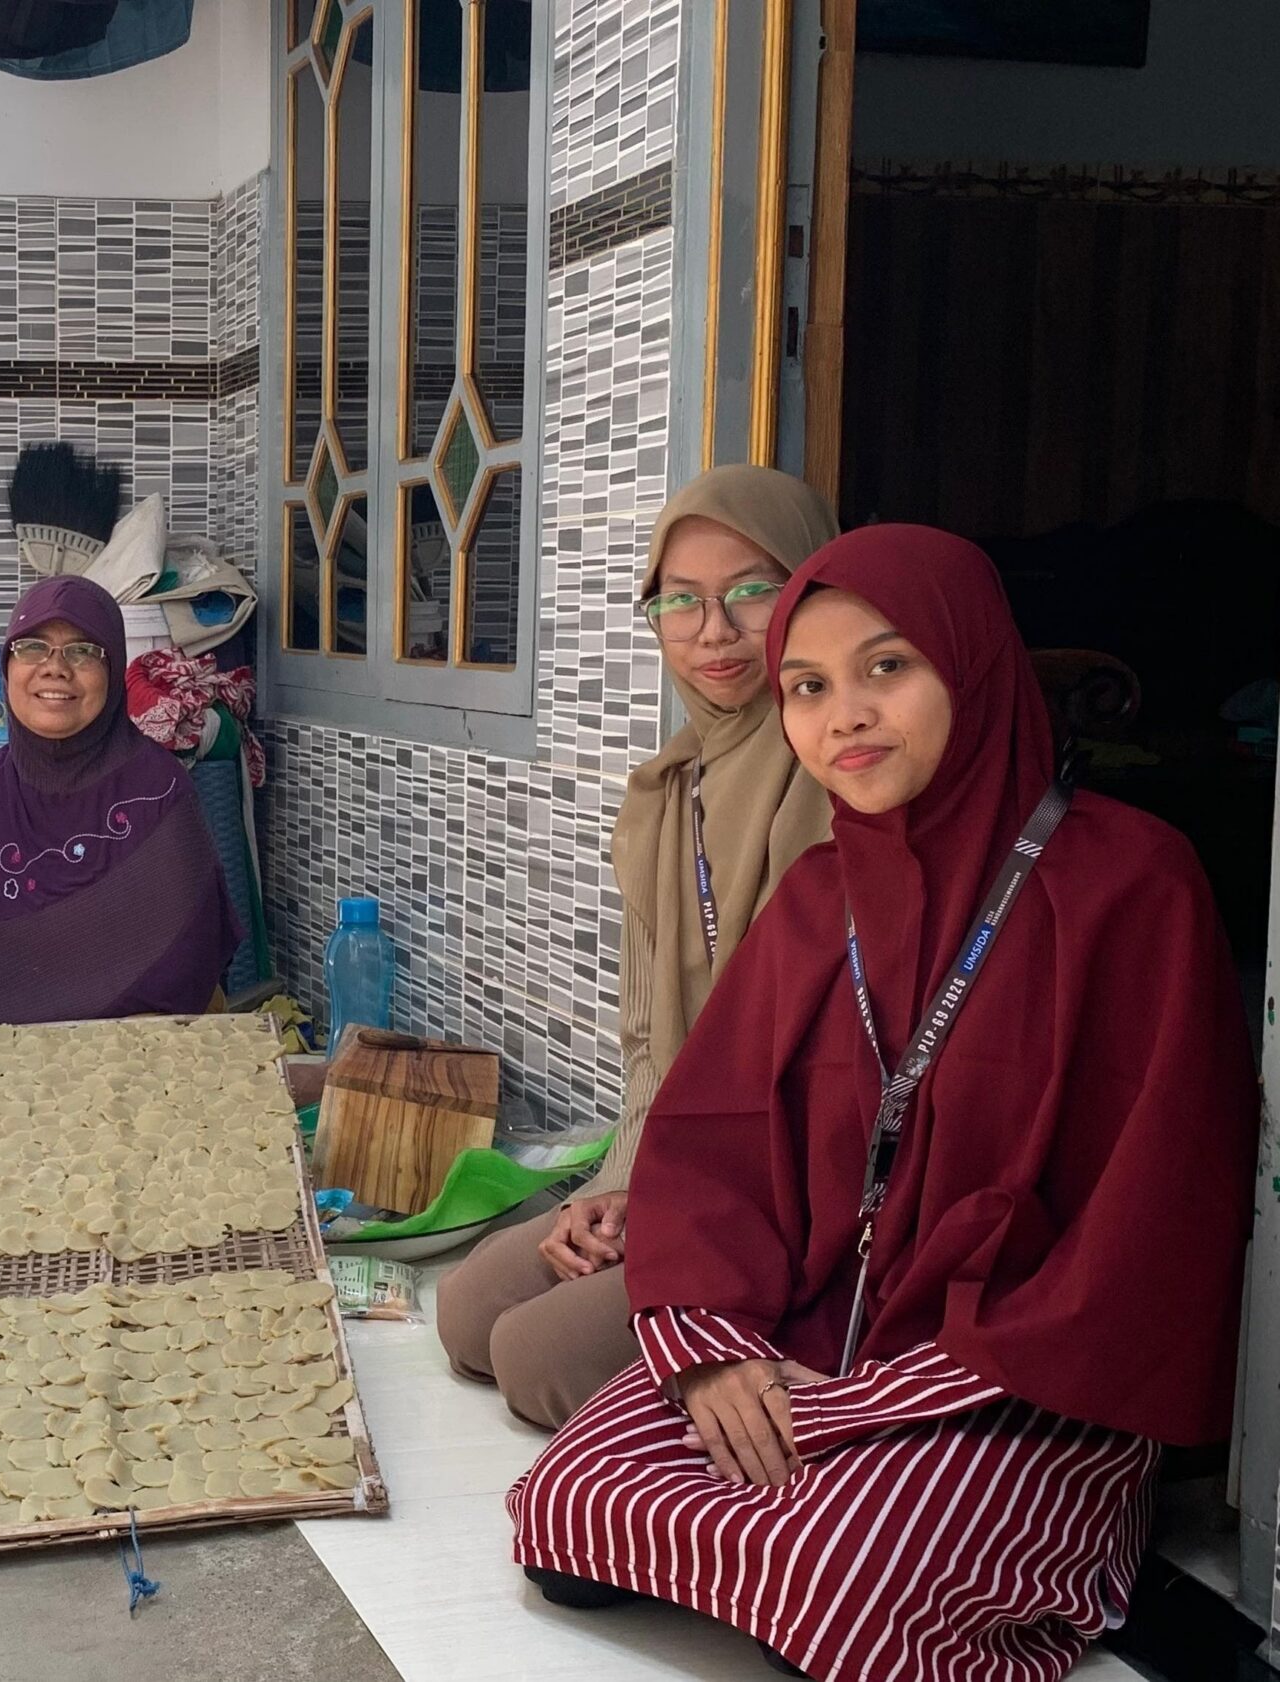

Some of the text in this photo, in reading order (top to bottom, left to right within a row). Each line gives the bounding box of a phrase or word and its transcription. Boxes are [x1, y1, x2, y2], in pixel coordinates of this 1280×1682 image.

[697, 859, 708, 894] UMSIDA
[703, 901, 717, 937] PLP-69
[850, 940, 861, 980] UMSIDA
[917, 929, 991, 1054] PLP-69 2026 UMSIDA
